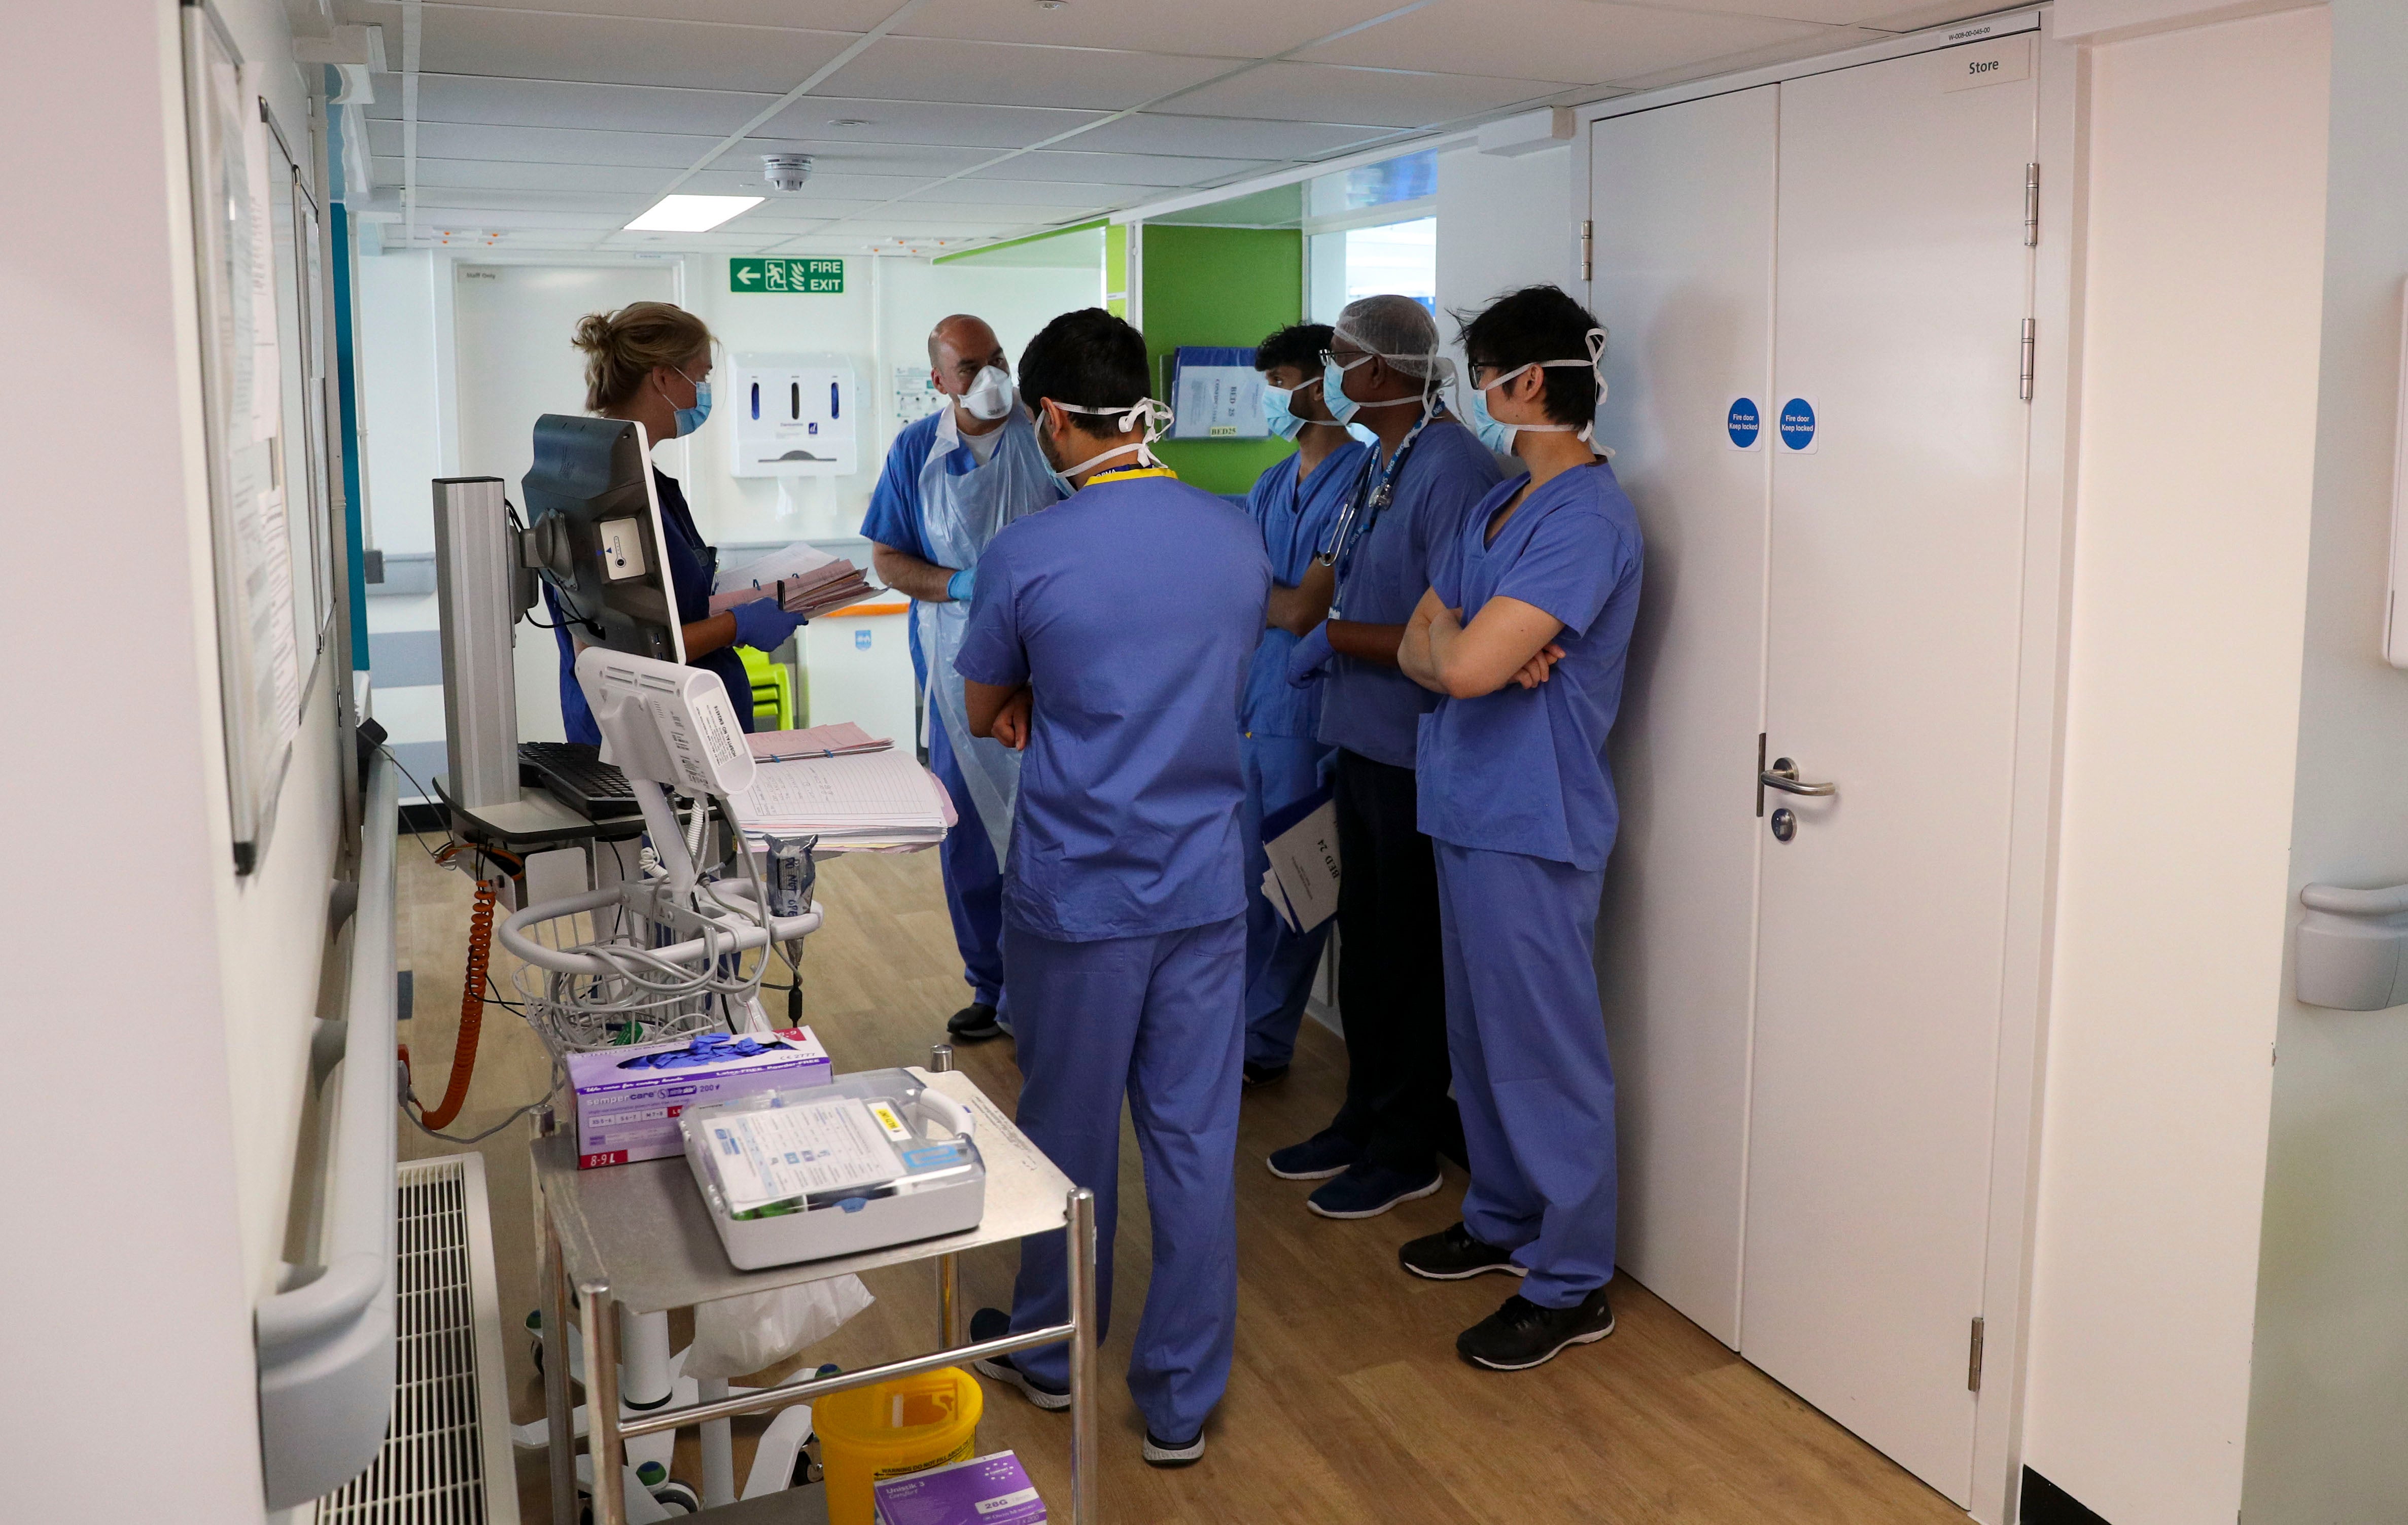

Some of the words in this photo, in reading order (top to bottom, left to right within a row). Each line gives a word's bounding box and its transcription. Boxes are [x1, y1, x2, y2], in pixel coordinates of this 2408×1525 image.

[1969, 60, 1999, 75] Store
[810, 262, 841, 273] FIRE
[810, 278, 841, 291] EXIT
[1229, 408, 1235, 417] 25
[1782, 424, 1795, 432] Keep
[1395, 442, 1405, 457] NHS
[1386, 459, 1395, 474] NHS
[725, 734, 737, 757] HOSPITAL
[1317, 839, 1328, 852] 24
[1325, 856, 1340, 879] BED
[591, 1154, 607, 1166] 8-9
[610, 1153, 616, 1163] L
[882, 1465, 912, 1473] WARNING
[886, 1483, 917, 1494] Unistik
[985, 1499, 1008, 1509] 28G
